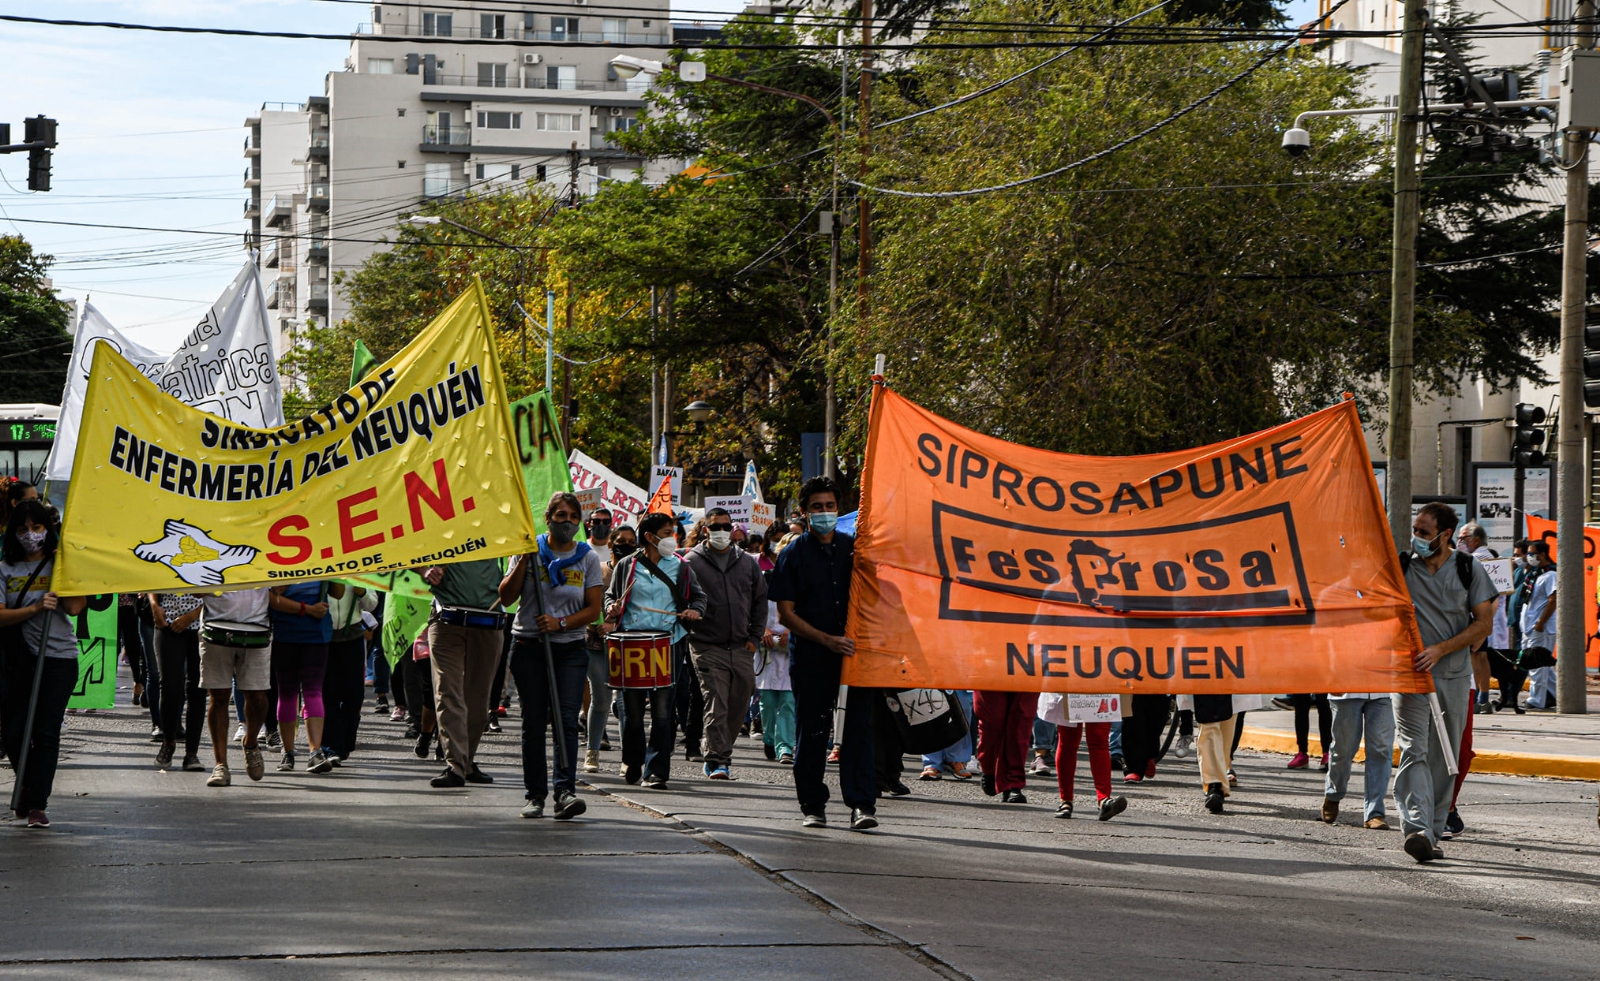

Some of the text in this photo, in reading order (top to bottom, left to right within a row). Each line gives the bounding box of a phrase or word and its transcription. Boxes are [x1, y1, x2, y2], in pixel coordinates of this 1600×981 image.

[10, 424, 24, 440] 17
[109, 424, 294, 501] ENFERMERÍA
[300, 438, 349, 485] DEL
[351, 361, 486, 461] NEUQUÉN
[201, 391, 360, 450] SINDICATO
[366, 367, 397, 413] DE
[569, 462, 643, 515] GUARD
[917, 433, 1309, 515] SIPROSAPUNE
[265, 458, 475, 565] S.E.N.
[267, 553, 384, 578] SINDICATO DE
[411, 537, 487, 565] NEUQUÉN
[1006, 643, 1245, 681] NEUQUEN
